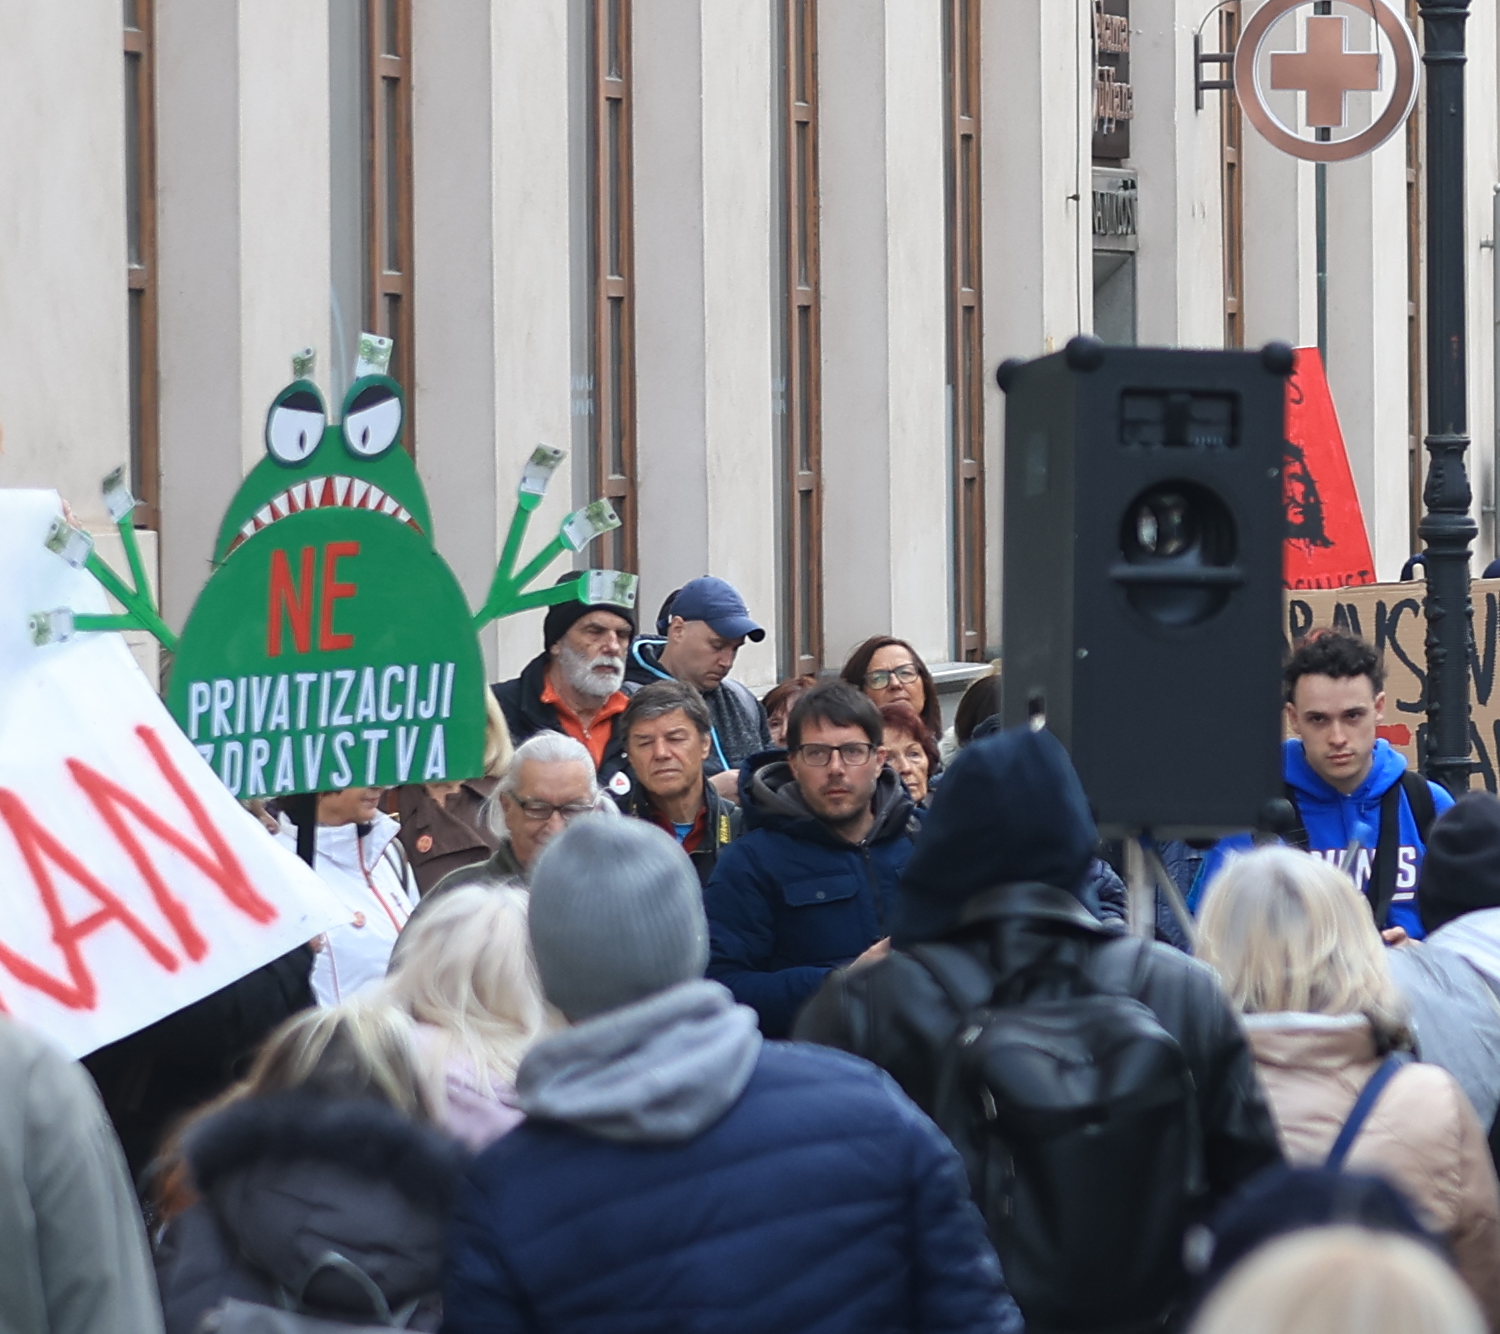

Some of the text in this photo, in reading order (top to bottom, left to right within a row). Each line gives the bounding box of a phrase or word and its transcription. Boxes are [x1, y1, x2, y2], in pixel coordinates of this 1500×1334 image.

[267, 541, 360, 657] NE
[188, 662, 455, 740] PRIVATIZACIJI
[196, 724, 447, 796] ZDRAVSTVA
[0, 722, 282, 1014] AN
